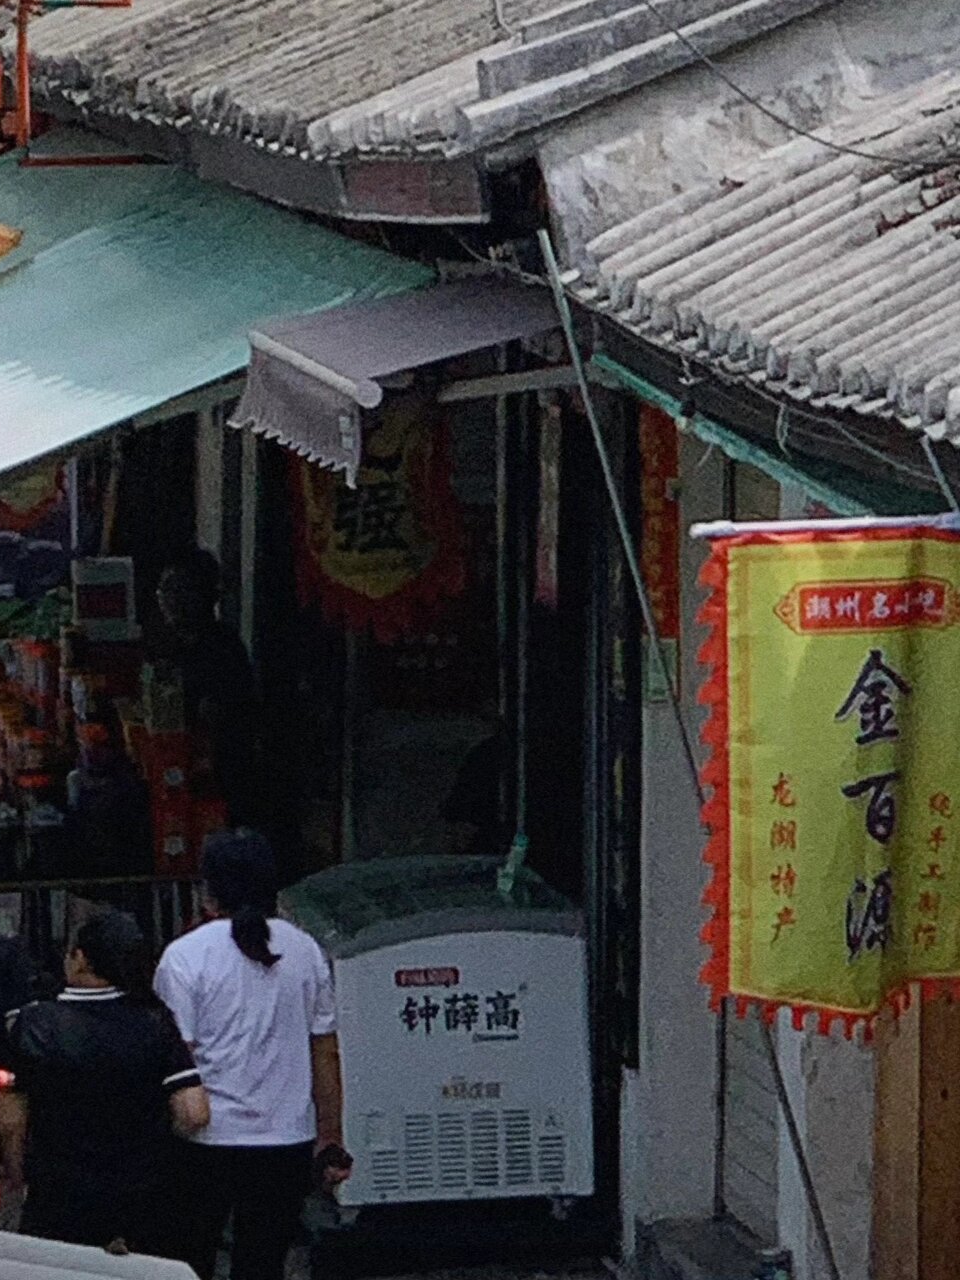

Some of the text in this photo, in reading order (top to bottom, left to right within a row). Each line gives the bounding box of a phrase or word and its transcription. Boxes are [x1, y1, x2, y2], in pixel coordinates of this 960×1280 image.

[770, 771, 798, 948] 龙湖特产
[400, 990, 520, 1035] 钟薛高
